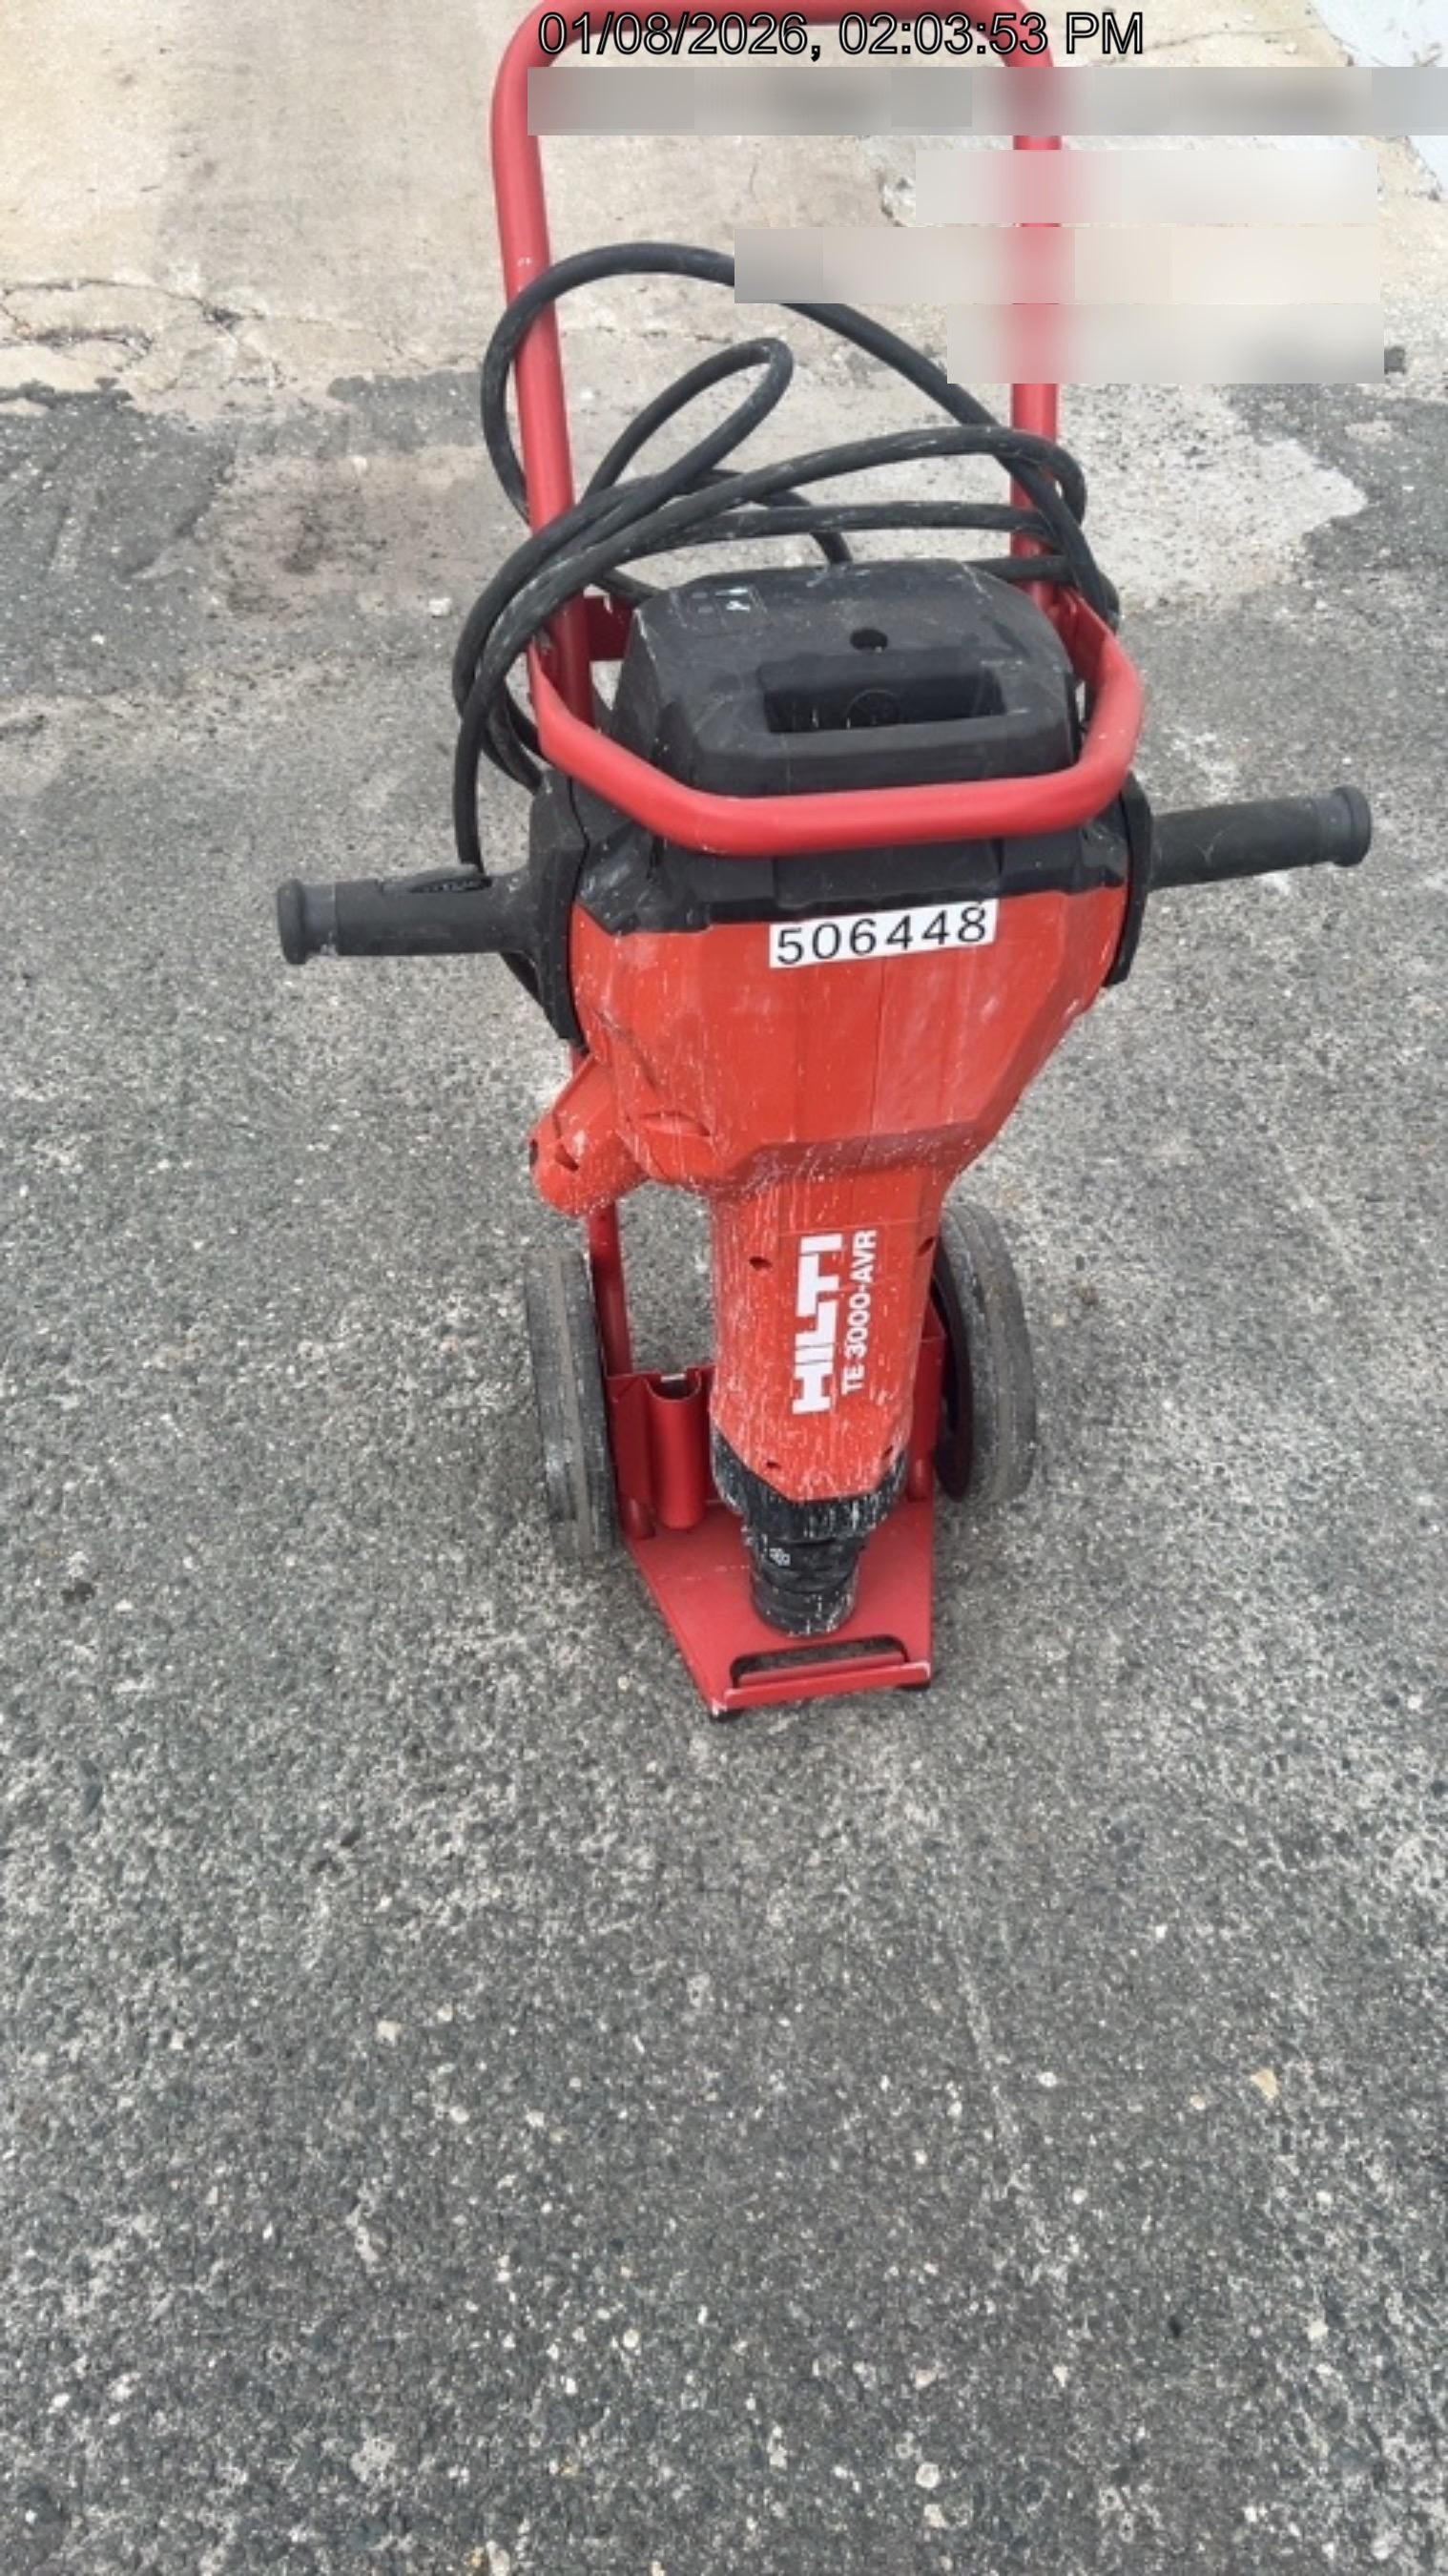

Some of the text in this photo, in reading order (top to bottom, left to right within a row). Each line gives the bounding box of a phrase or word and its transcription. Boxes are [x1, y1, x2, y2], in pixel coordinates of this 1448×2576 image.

[777, 905, 986, 965] 506448
[792, 1234, 843, 1415] HILTI
[840, 1230, 878, 1396] TE 3000-AVR
